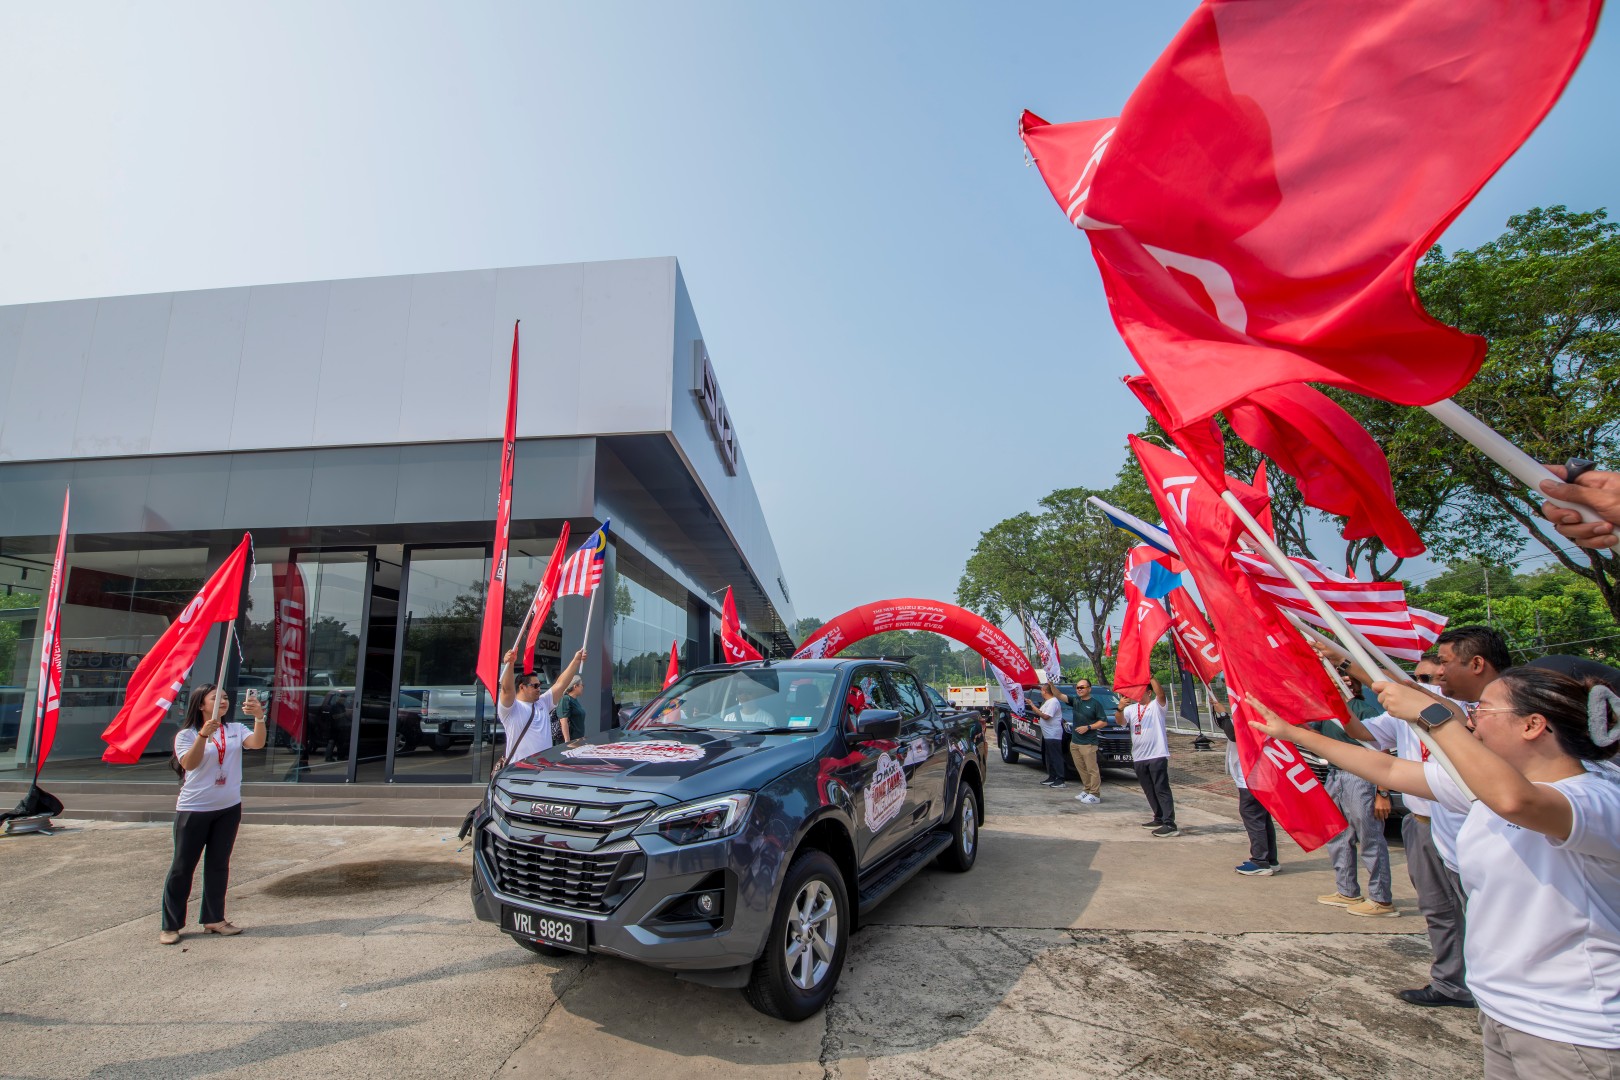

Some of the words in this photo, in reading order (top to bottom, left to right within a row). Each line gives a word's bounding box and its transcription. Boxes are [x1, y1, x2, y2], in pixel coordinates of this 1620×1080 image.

[873, 610, 947, 626] 2.2TD
[874, 623, 893, 631] BEST
[924, 622, 944, 630] EVER
[976, 630, 1025, 675] D-MAX
[981, 624, 993, 636] THE
[993, 633, 1009, 647] NEW
[1007, 645, 1029, 671] ISUZU
[531, 802, 574, 817] ISUZU
[513, 911, 536, 935] VRL
[540, 918, 573, 943] 9829
